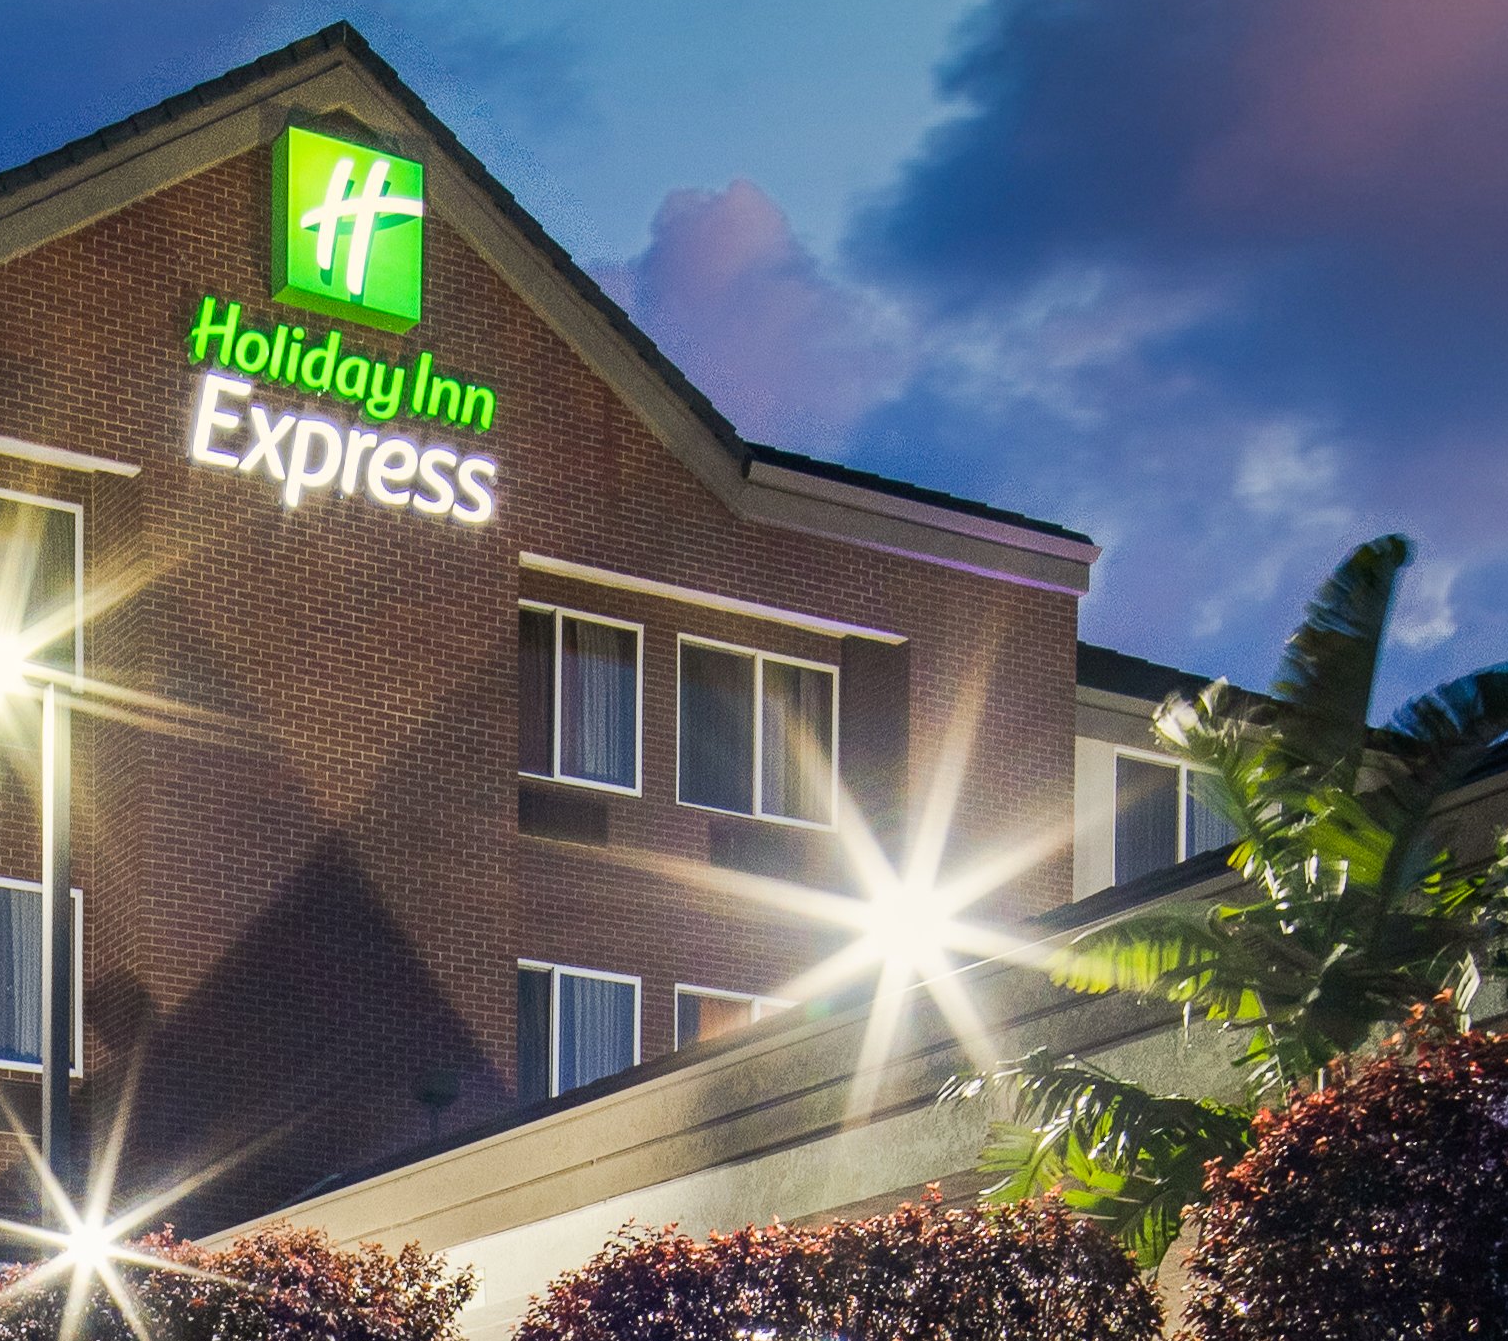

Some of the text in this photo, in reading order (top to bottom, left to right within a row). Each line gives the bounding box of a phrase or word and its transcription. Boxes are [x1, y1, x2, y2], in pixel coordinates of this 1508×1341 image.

[301, 159, 423, 295] H
[190, 296, 496, 431] Holiday Inn
[191, 373, 497, 523] Express
